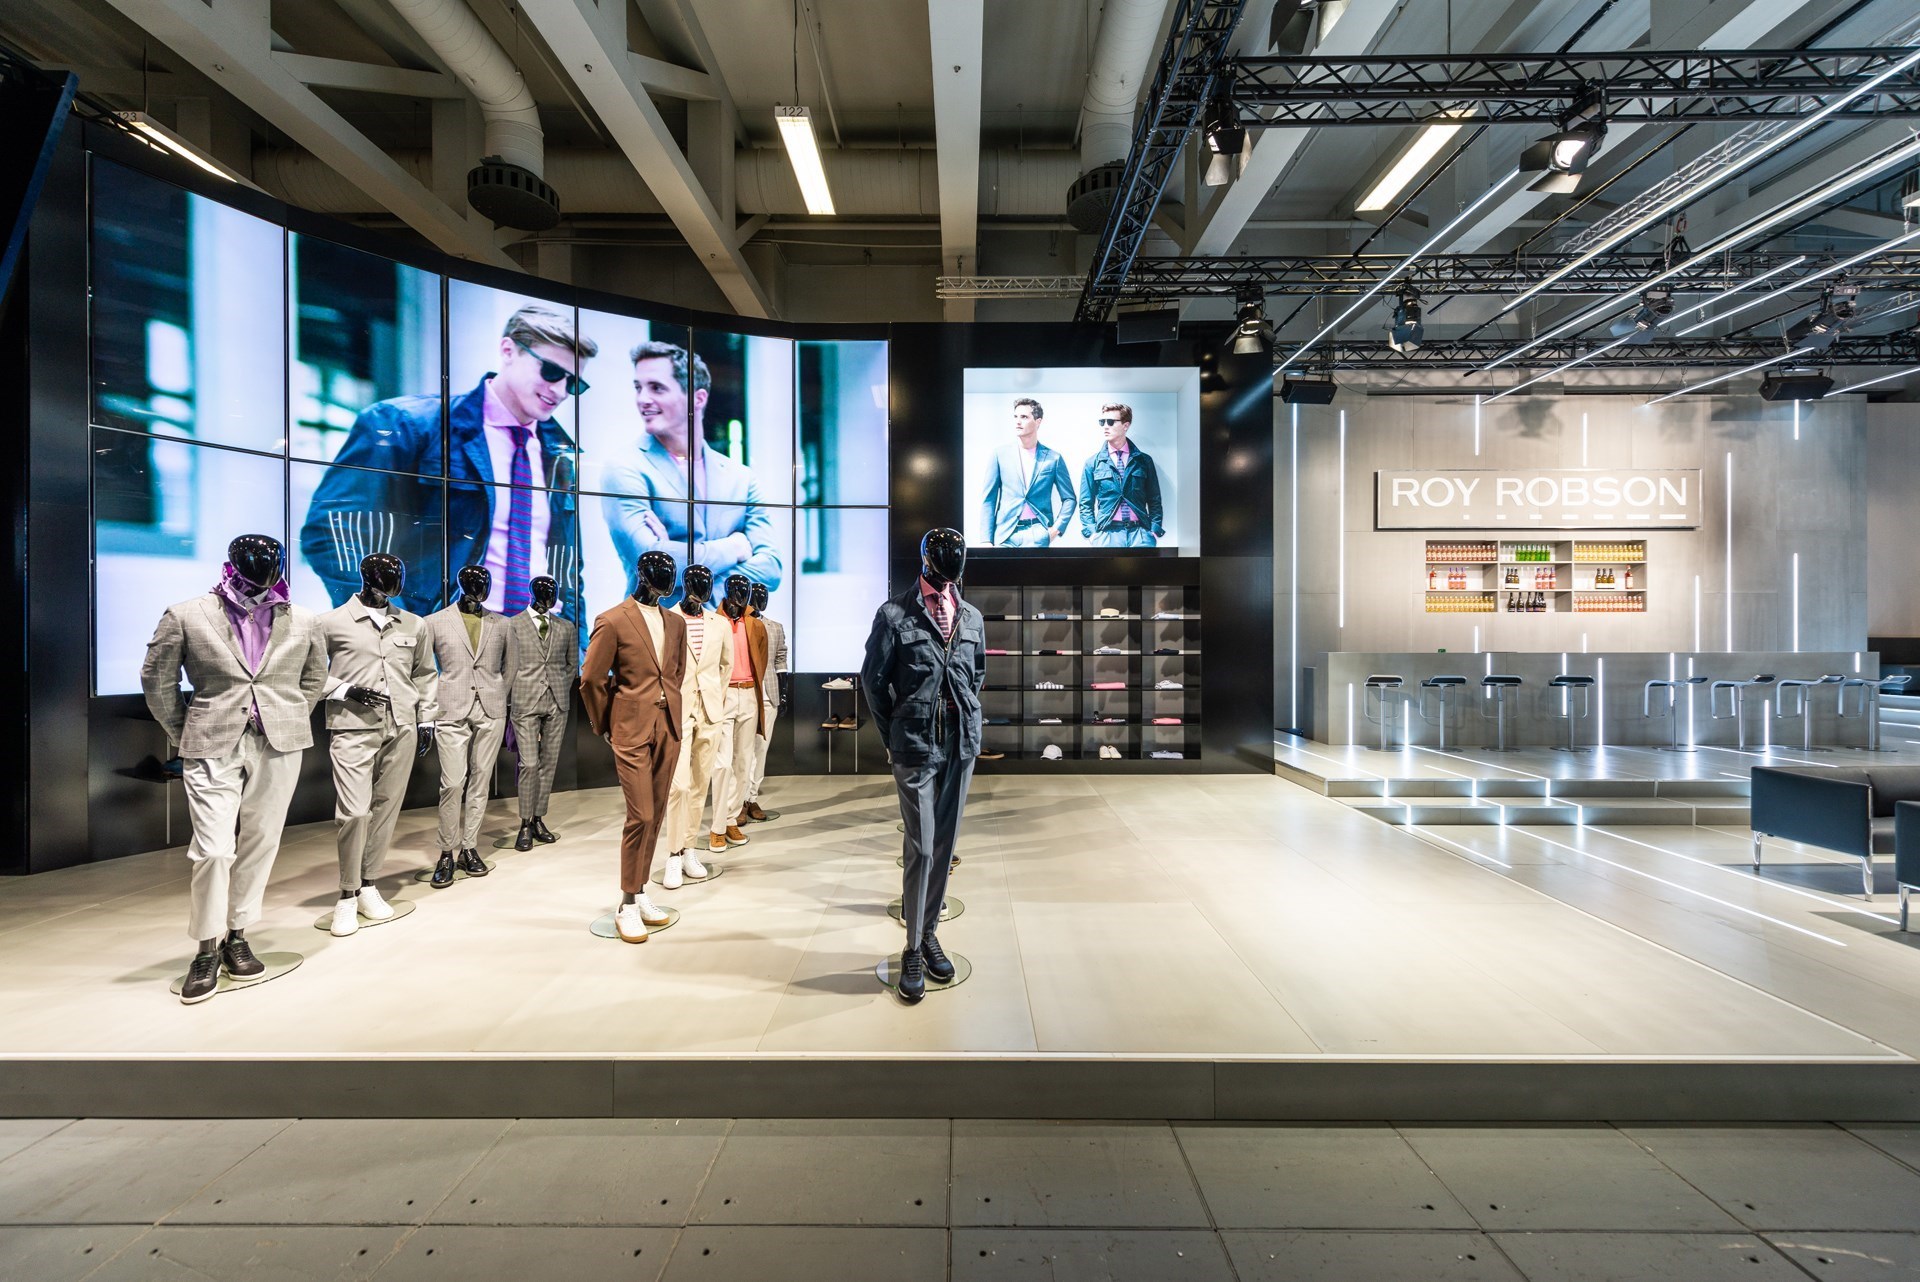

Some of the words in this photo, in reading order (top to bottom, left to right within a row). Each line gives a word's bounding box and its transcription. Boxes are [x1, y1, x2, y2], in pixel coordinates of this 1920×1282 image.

[782, 107, 803, 117] 122
[1391, 477, 1480, 507] ROY
[1496, 477, 1687, 507] ROBSON
